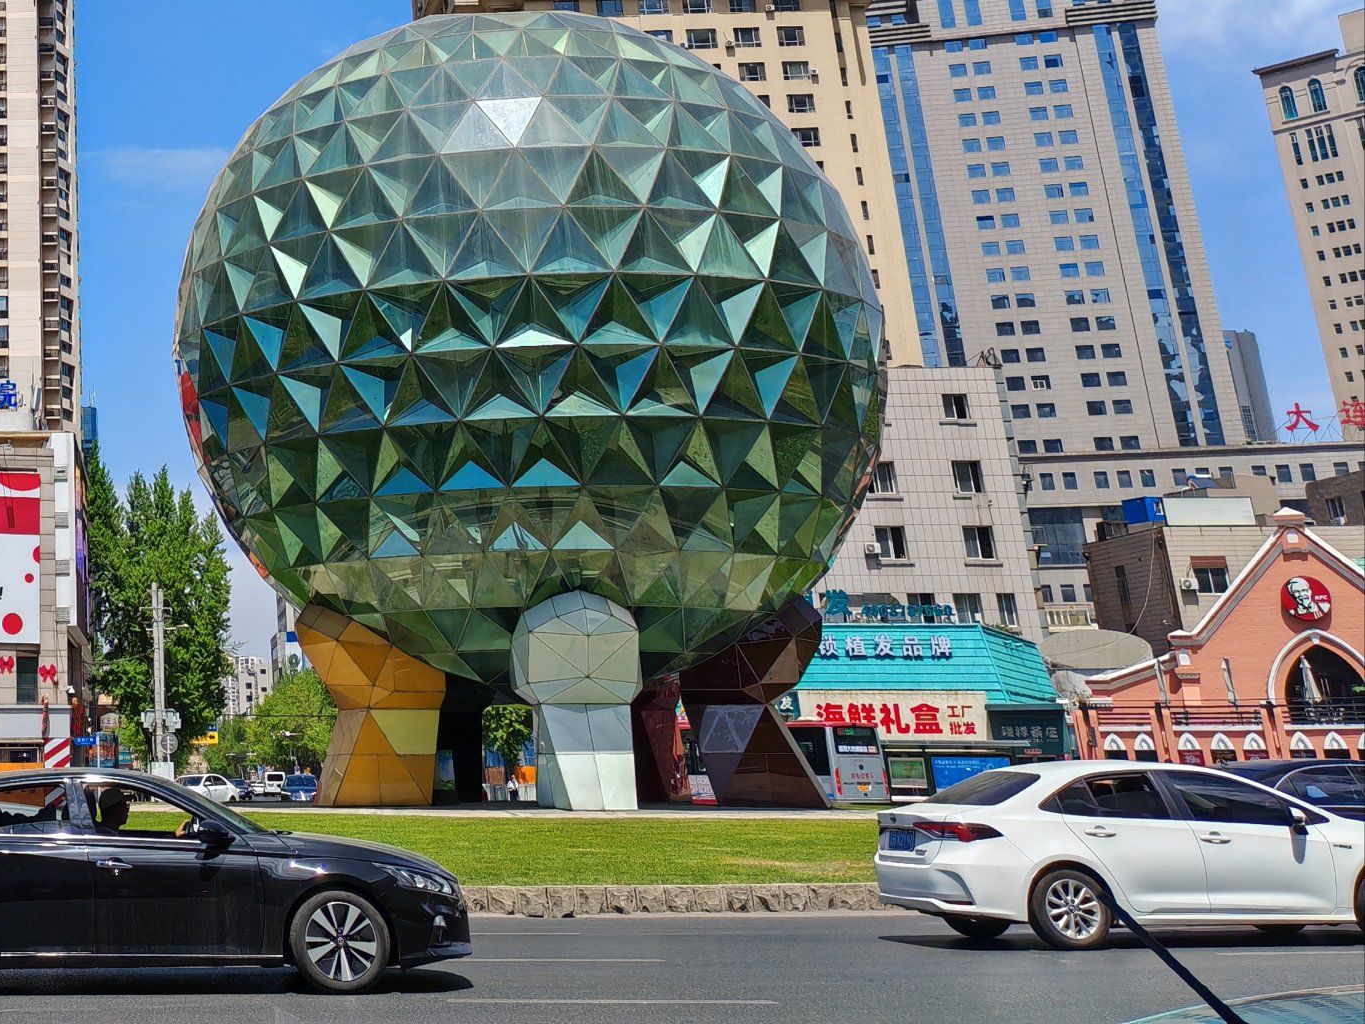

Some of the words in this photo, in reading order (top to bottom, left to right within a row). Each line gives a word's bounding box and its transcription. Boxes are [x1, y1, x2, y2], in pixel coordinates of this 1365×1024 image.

[816, 703, 943, 735] 海鲜礼盒
[947, 705, 973, 718] 工厂
[949, 721, 977, 735] 批发
